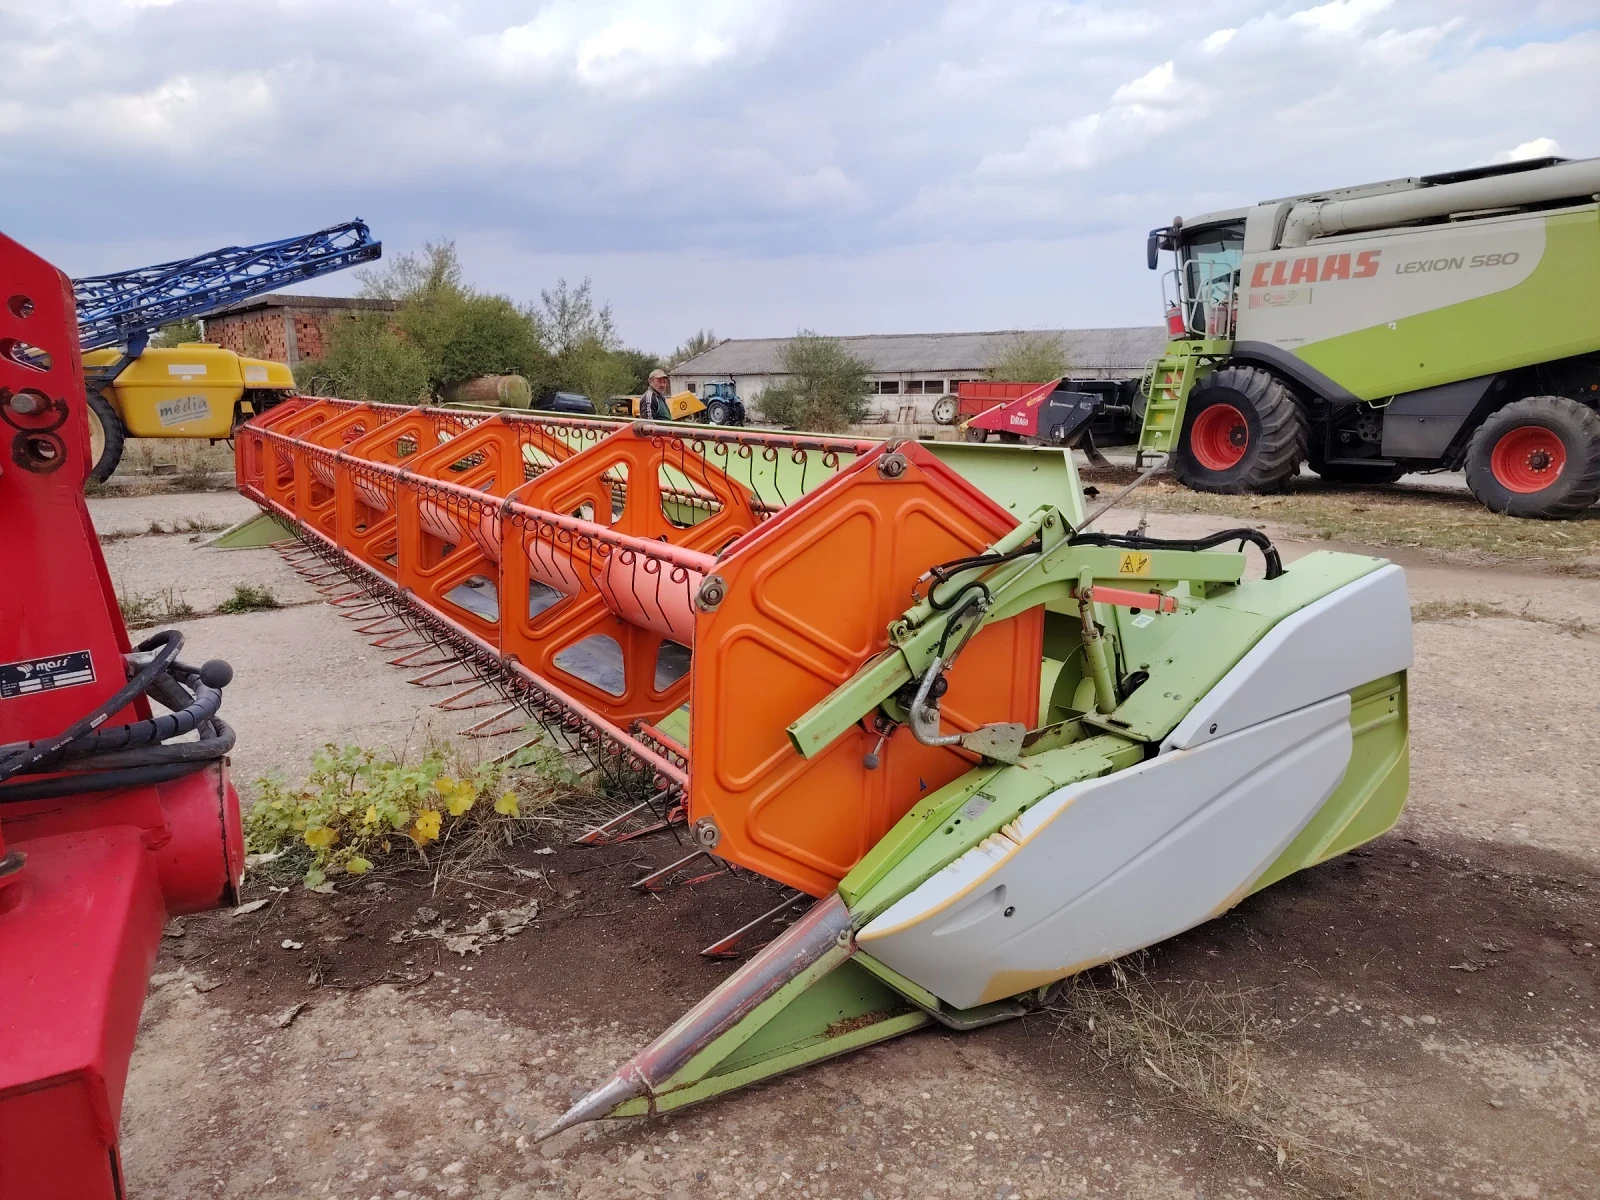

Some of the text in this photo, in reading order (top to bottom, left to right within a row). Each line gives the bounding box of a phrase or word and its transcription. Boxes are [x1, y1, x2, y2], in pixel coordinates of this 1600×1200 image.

[1250, 250, 1382, 288] CLAAS
[1395, 252, 1520, 275] LEXION 580
[159, 397, 208, 418] média
[36, 658, 68, 671] mass
